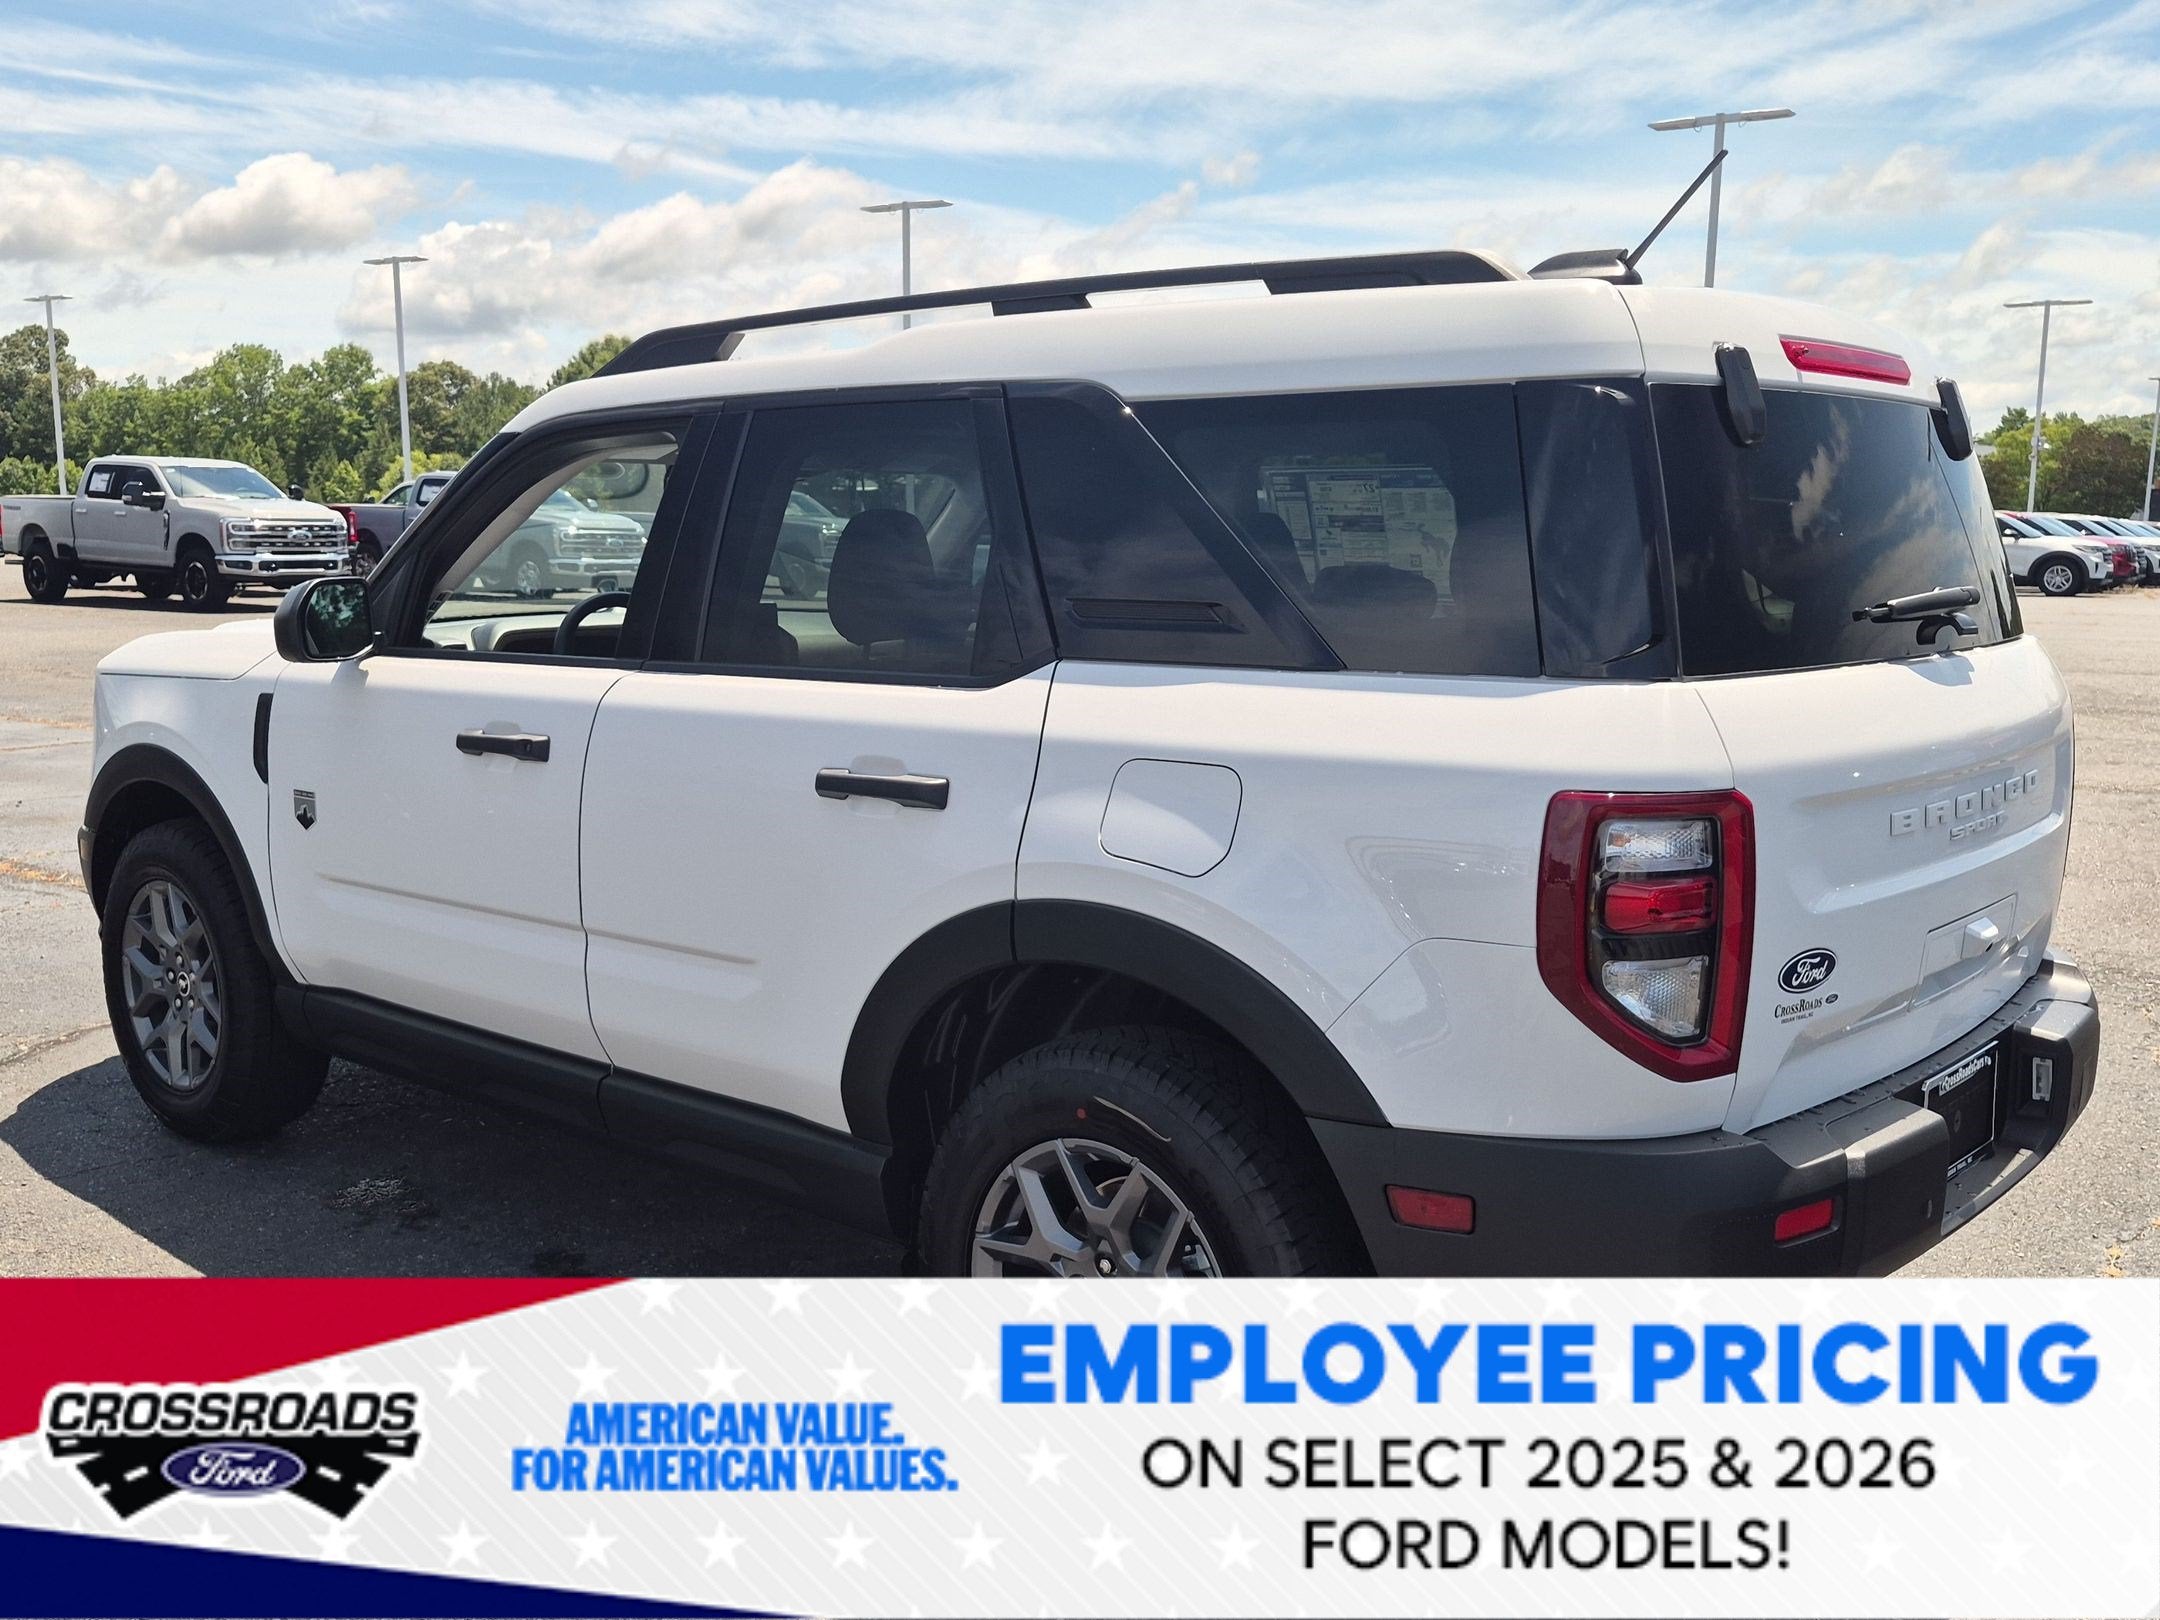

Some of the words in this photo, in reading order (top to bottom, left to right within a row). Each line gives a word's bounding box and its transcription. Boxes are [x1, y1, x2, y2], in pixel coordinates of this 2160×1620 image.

[1889, 768, 2039, 837] BRONCO
[1949, 810, 2006, 841] SPORT
[1792, 956, 1828, 987] Ford
